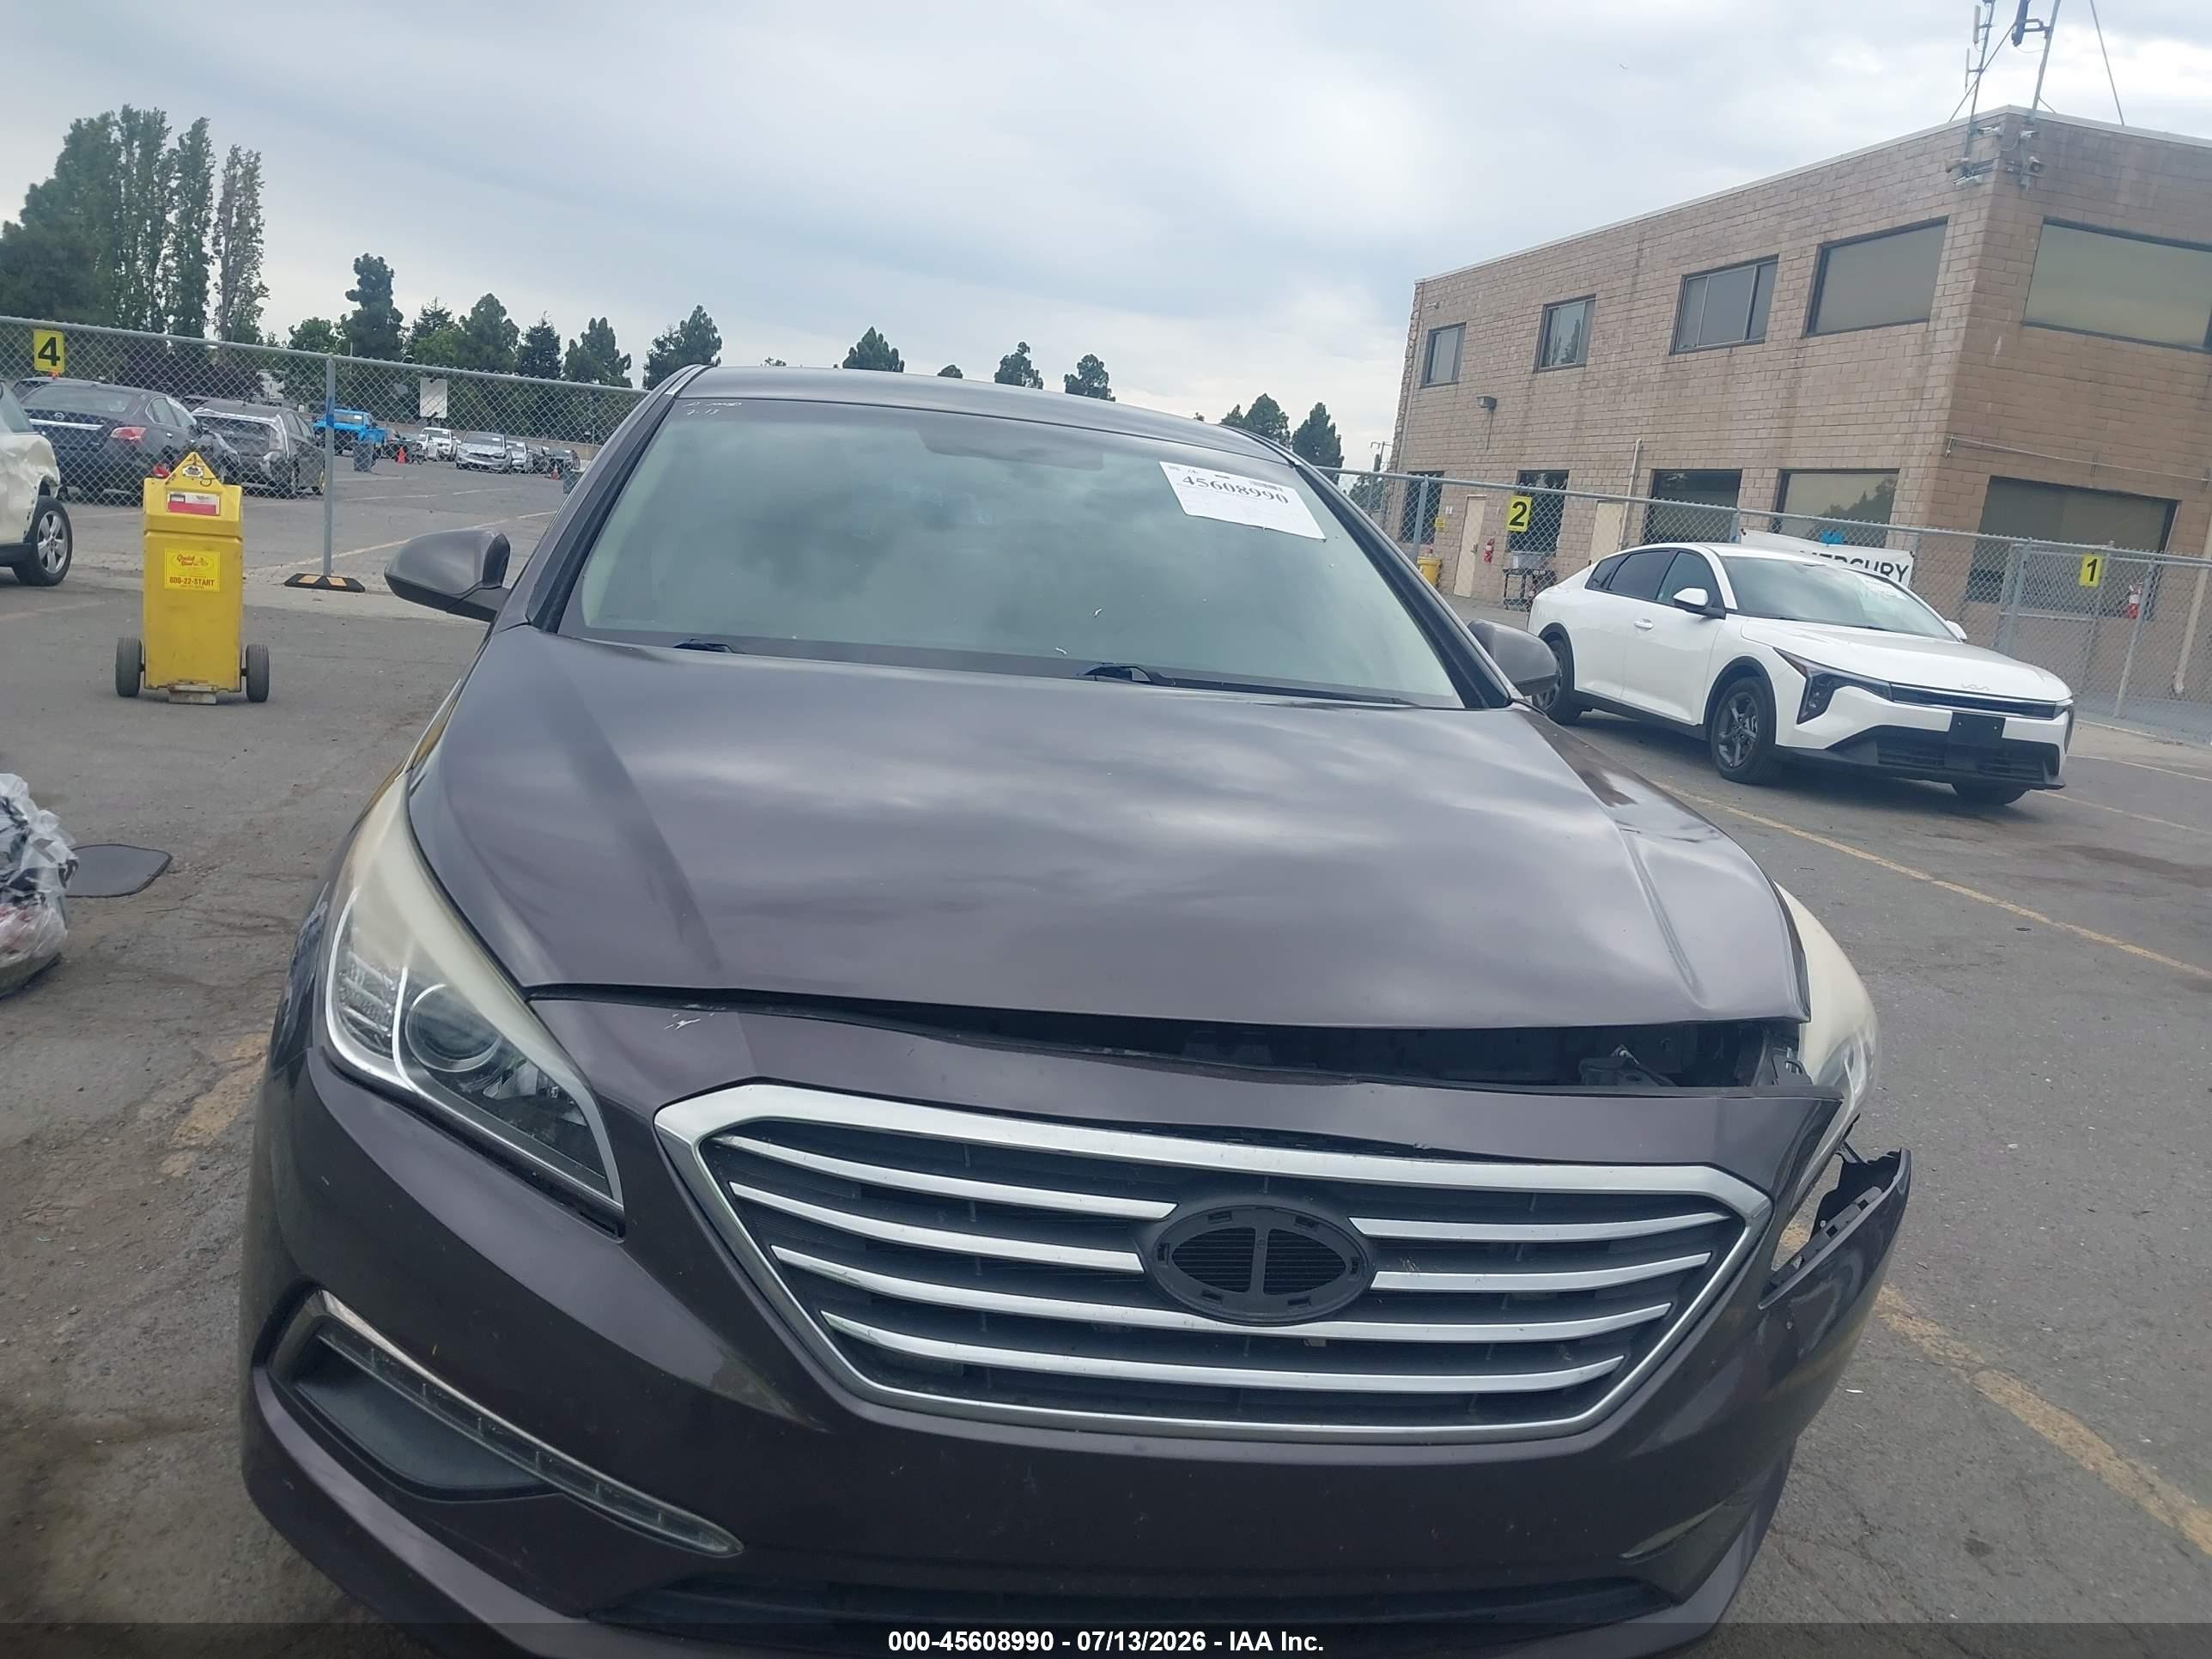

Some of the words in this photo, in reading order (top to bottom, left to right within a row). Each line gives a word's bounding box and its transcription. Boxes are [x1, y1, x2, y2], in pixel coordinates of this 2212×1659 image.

[38, 336, 61, 367] 4
[1182, 475, 1290, 505] 45608990
[1509, 501, 1528, 527] 2
[2087, 558, 2098, 582] 1
